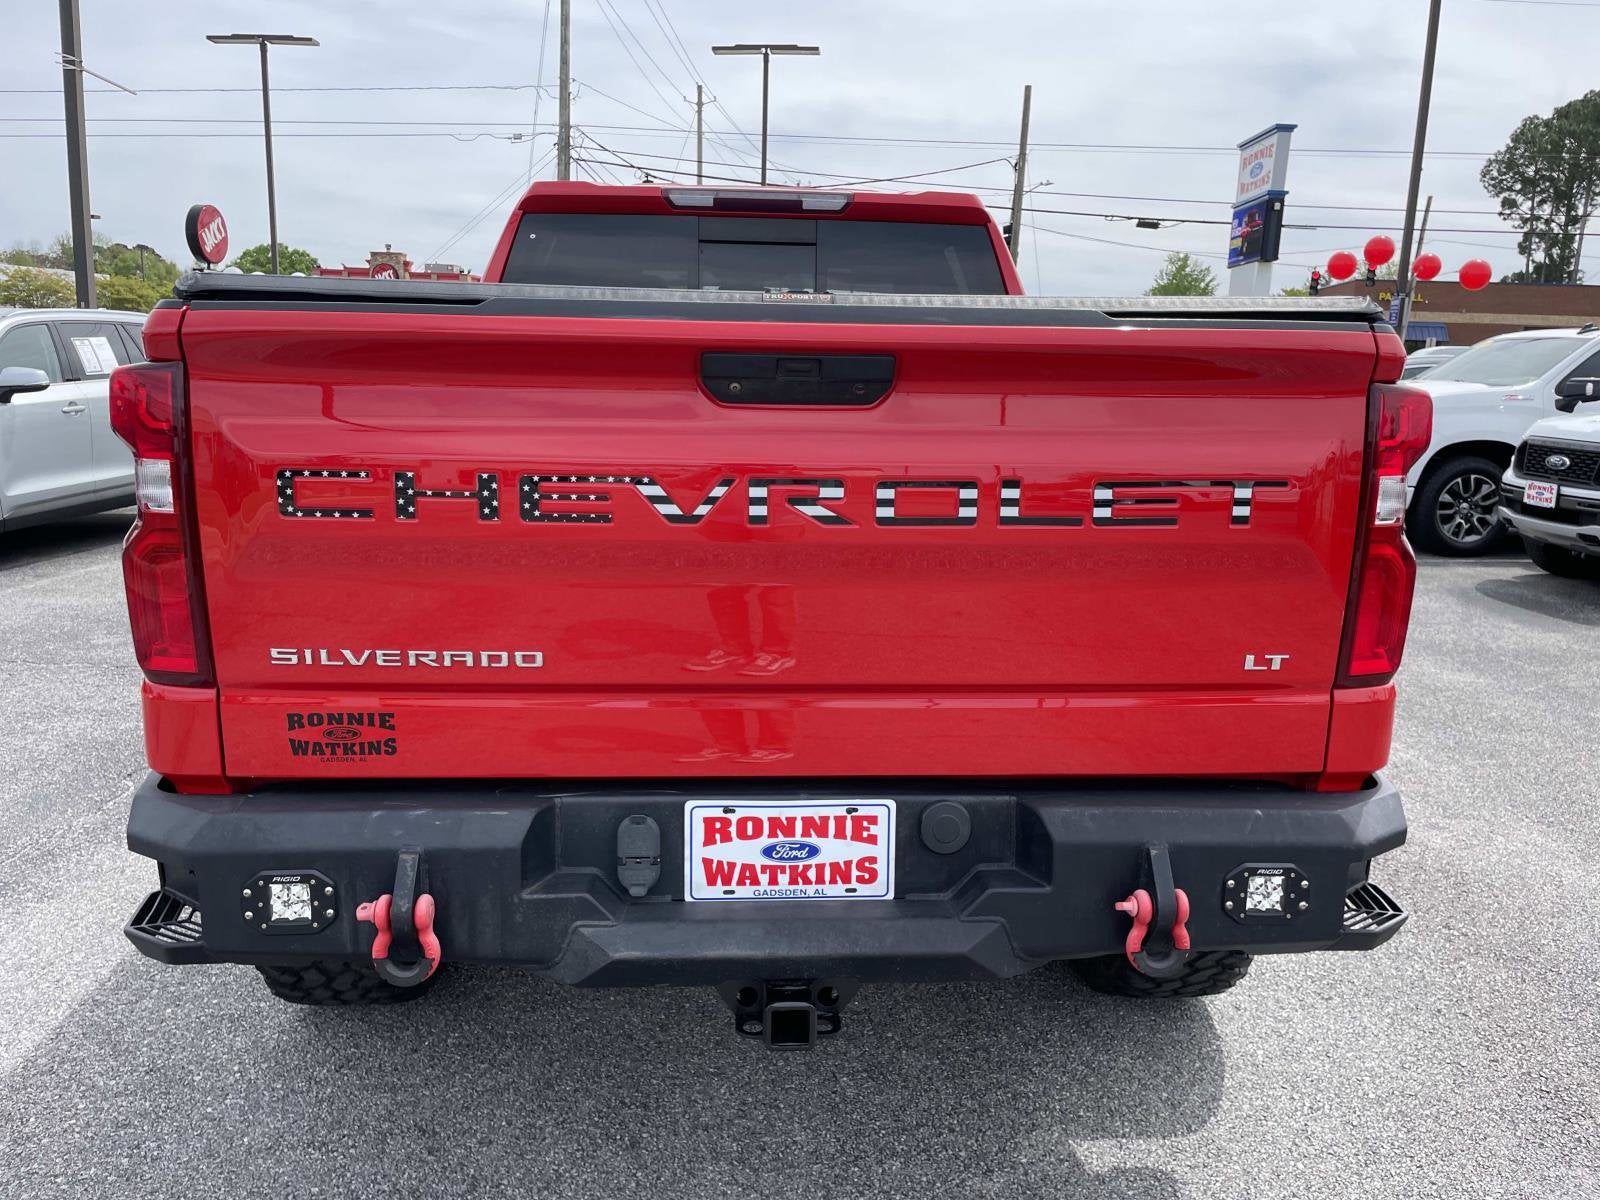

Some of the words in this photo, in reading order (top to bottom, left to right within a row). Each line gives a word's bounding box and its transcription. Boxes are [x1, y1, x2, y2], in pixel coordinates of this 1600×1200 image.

[276, 468, 1291, 527] CHEVROLET
[269, 647, 544, 668] SILVERADO
[1244, 654, 1290, 671] LT
[286, 712, 396, 731] RONNIE
[288, 738, 397, 756] WATKINS
[702, 815, 878, 847] RONNIE
[771, 843, 810, 860] Ford
[701, 855, 879, 887] WATKINS
[752, 888, 810, 898] GADSDEN,
[813, 887, 828, 897] AL
